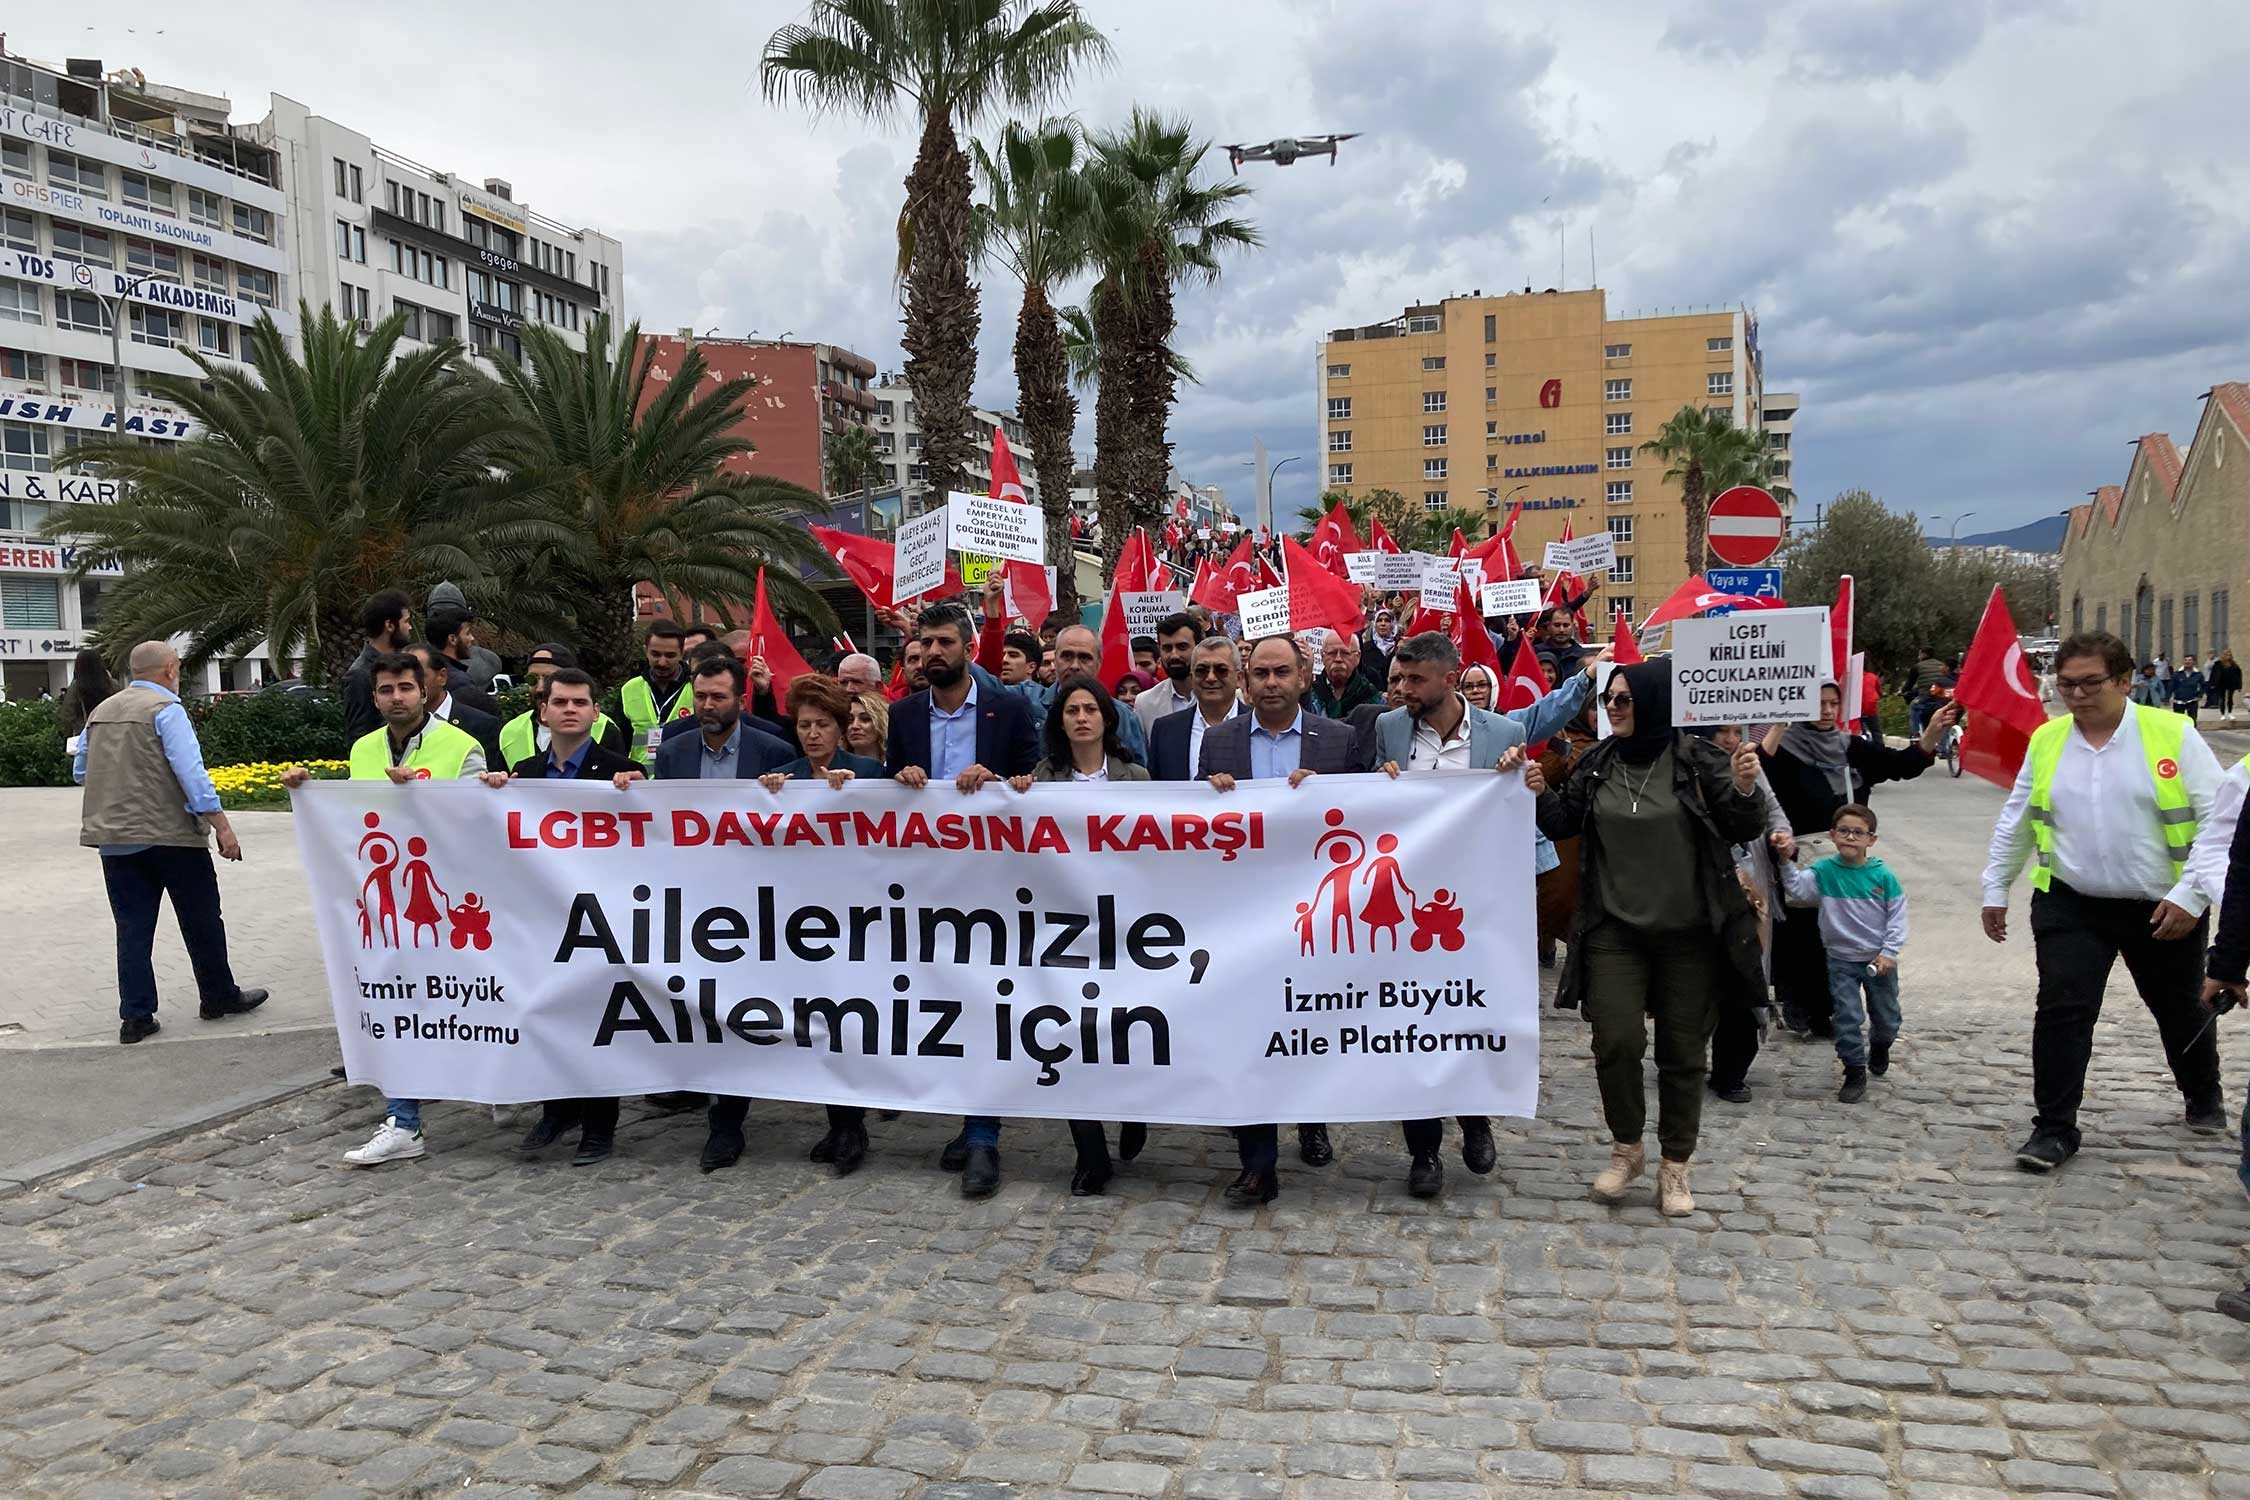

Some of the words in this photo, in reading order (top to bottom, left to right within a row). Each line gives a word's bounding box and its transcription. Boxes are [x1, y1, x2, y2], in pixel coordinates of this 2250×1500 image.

[22, 113, 75, 148] CAFE
[98, 206, 152, 231] TOPLANTI
[154, 221, 212, 247] SALONLARI
[17, 253, 54, 279] YDS
[480, 250, 519, 272] egegen
[101, 411, 190, 438] FAST
[1504, 463, 1598, 478] KALKINMANIN
[25, 476, 46, 499] &
[59, 479, 120, 504] KAR
[966, 508, 1027, 526] EMPERYALİST
[970, 499, 1008, 513] KÜRESEL
[1011, 507, 1023, 516] VE
[955, 524, 1038, 545] ÇOCUKLARIMIZDAN
[974, 536, 997, 547] UZAK
[999, 541, 1020, 551] DUR!
[1710, 572, 1735, 589] Yaya
[1736, 576, 1749, 586] ve
[1138, 594, 1162, 604] AİLEYİ
[1424, 588, 1453, 599] DERDİMİ
[1439, 598, 1455, 606] DAYA
[1126, 614, 1141, 625] İLLİ
[1129, 605, 1171, 614] KORUMAK
[1248, 621, 1274, 633] LGBT
[1729, 624, 1767, 640] LGBT
[1710, 642, 1745, 661] KİRLİ
[1750, 640, 1785, 660] ELİNİ
[1678, 664, 1816, 688] ÇOCUKLARIMIZIN
[1689, 686, 1773, 705] ÜZERİNDEN
[1778, 685, 1806, 705] ÇEK
[507, 810, 653, 849] LGBT
[672, 811, 1071, 854] DAYATMASINA
[1087, 812, 1265, 862] KARŞI
[554, 884, 1210, 985] Ailelerimizle,
[426, 975, 505, 1008] Büyük
[1284, 977, 1369, 1012] İzmir
[1379, 978, 1487, 1016] Büyük
[394, 1014, 519, 1045] Platformu
[593, 975, 964, 1058] Ailemiz
[996, 978, 1172, 1087] için
[1264, 1028, 1329, 1058] Aile
[1340, 1024, 1507, 1054] Platformu
